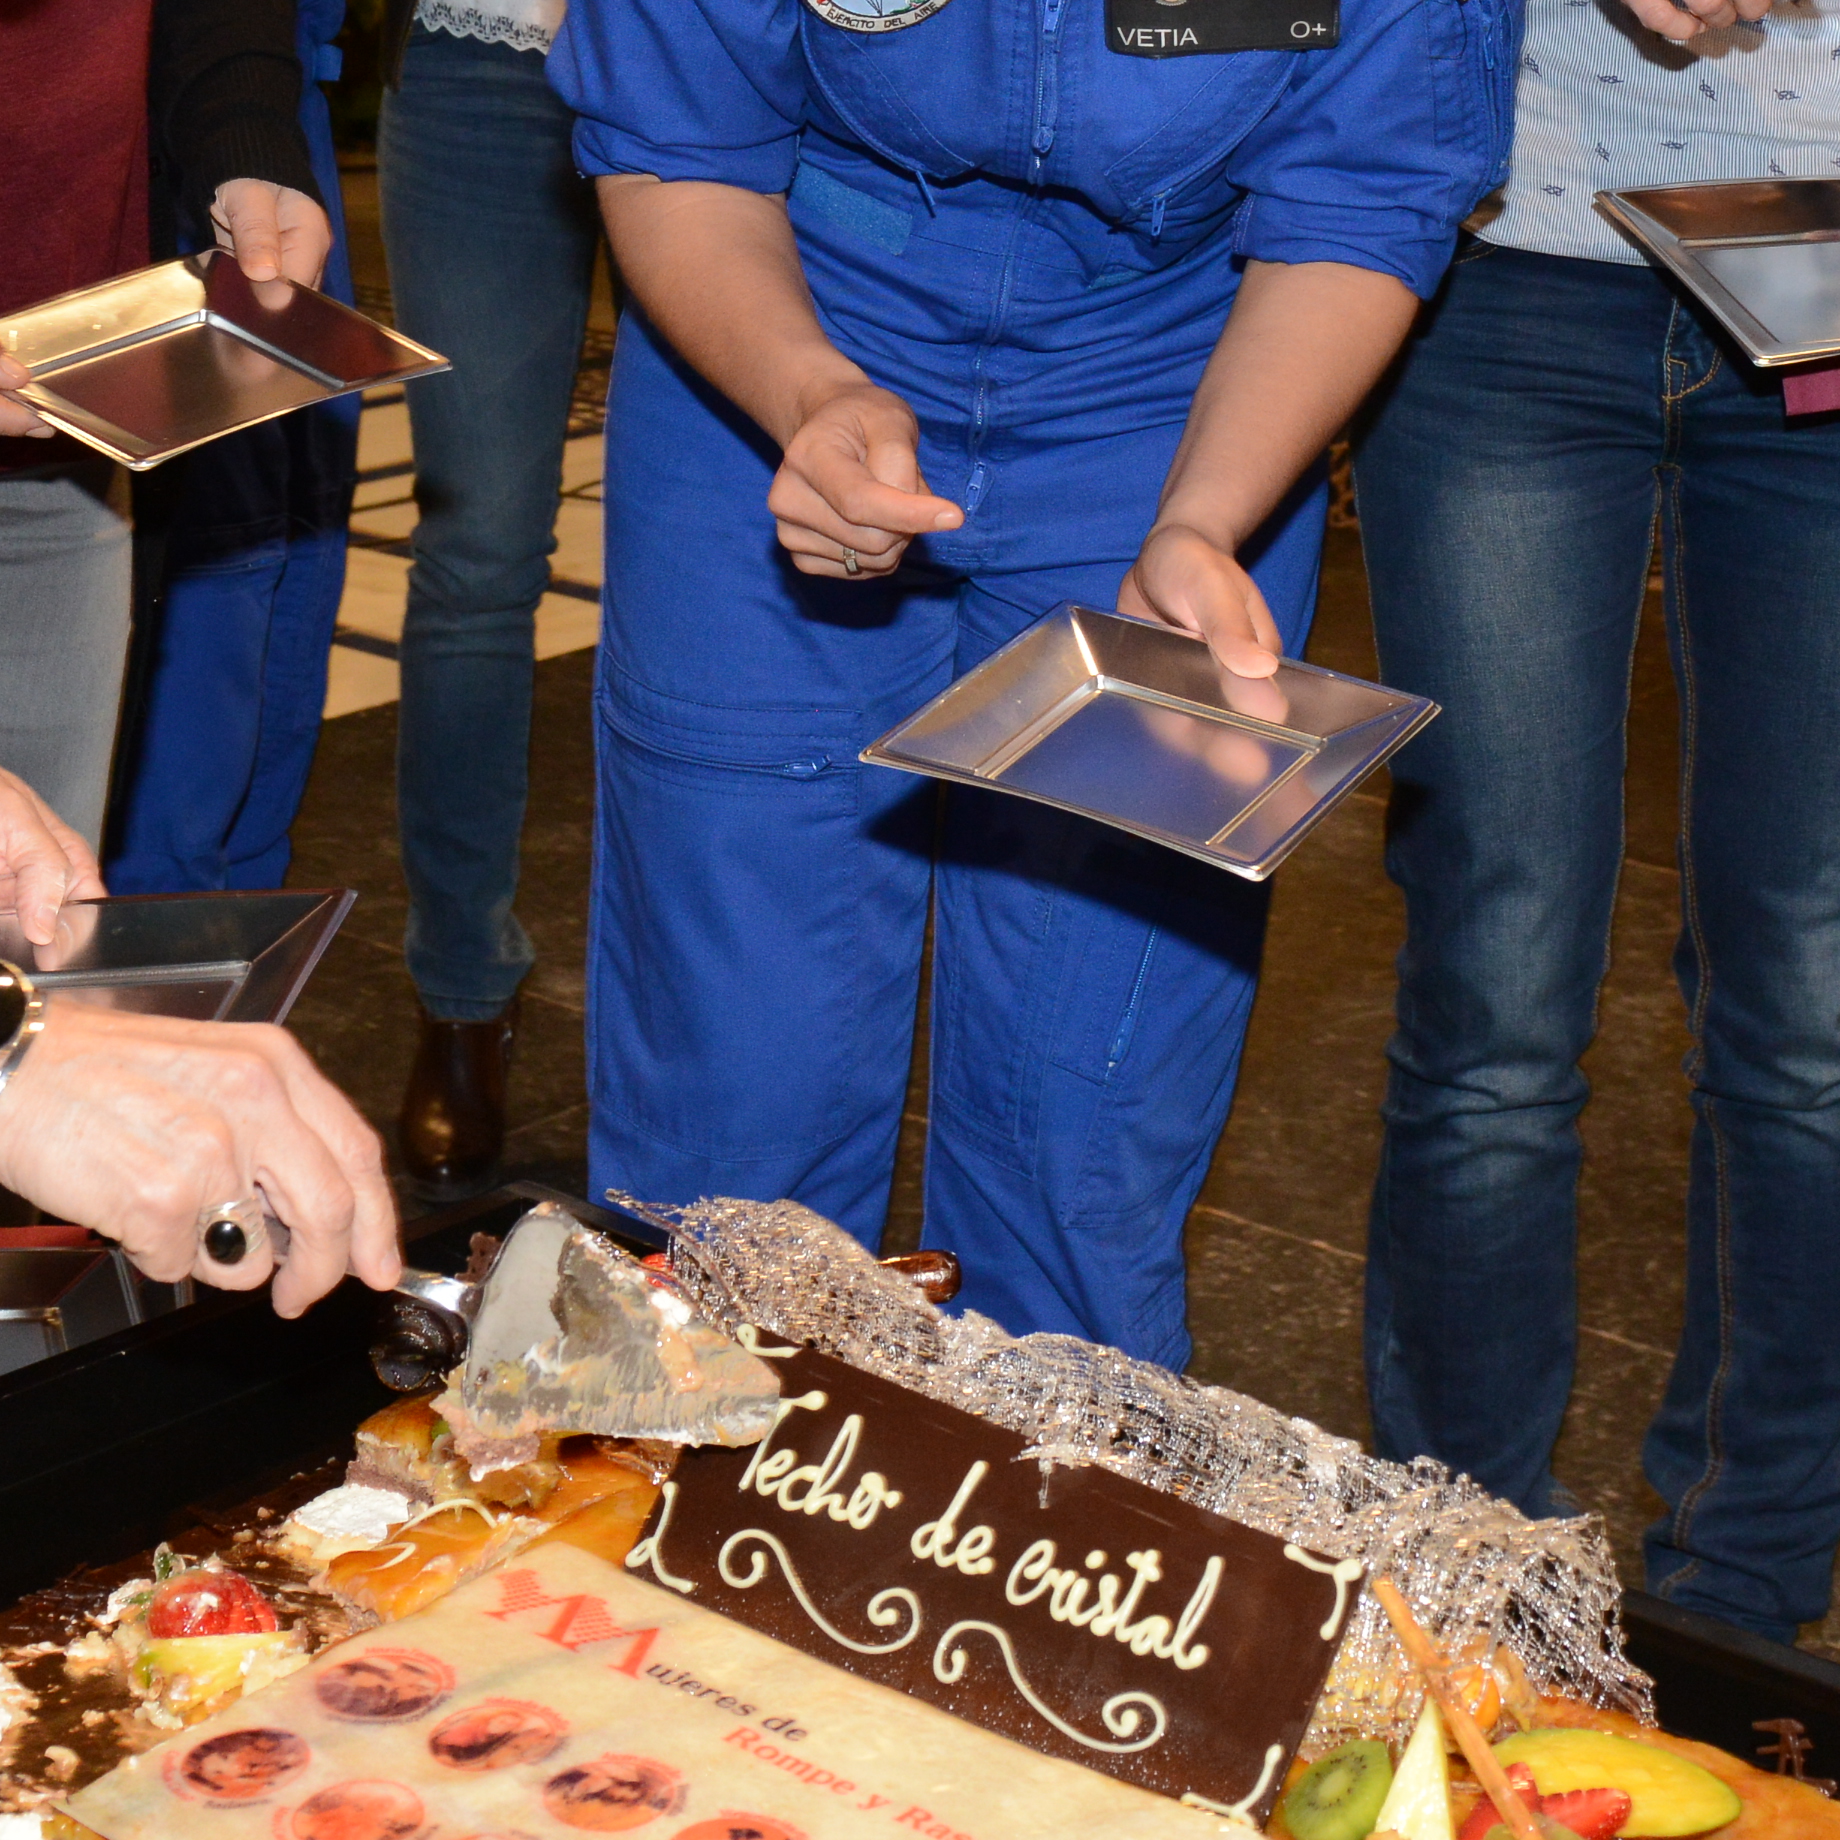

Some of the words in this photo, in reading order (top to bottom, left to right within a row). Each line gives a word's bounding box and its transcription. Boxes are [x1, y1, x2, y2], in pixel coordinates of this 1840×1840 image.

[826, 8, 875, 29] EJERCITO
[884, 17, 906, 29] DEL
[914, 2, 939, 21] AIRE
[1117, 26, 1199, 48] VETIA
[1289, 20, 1328, 39] O+
[737, 1389, 904, 1531] Techo
[910, 1459, 997, 1576] de
[762, 1715, 809, 1743] de
[722, 1725, 857, 1797] Rompe
[856, 1793, 891, 1811] y
